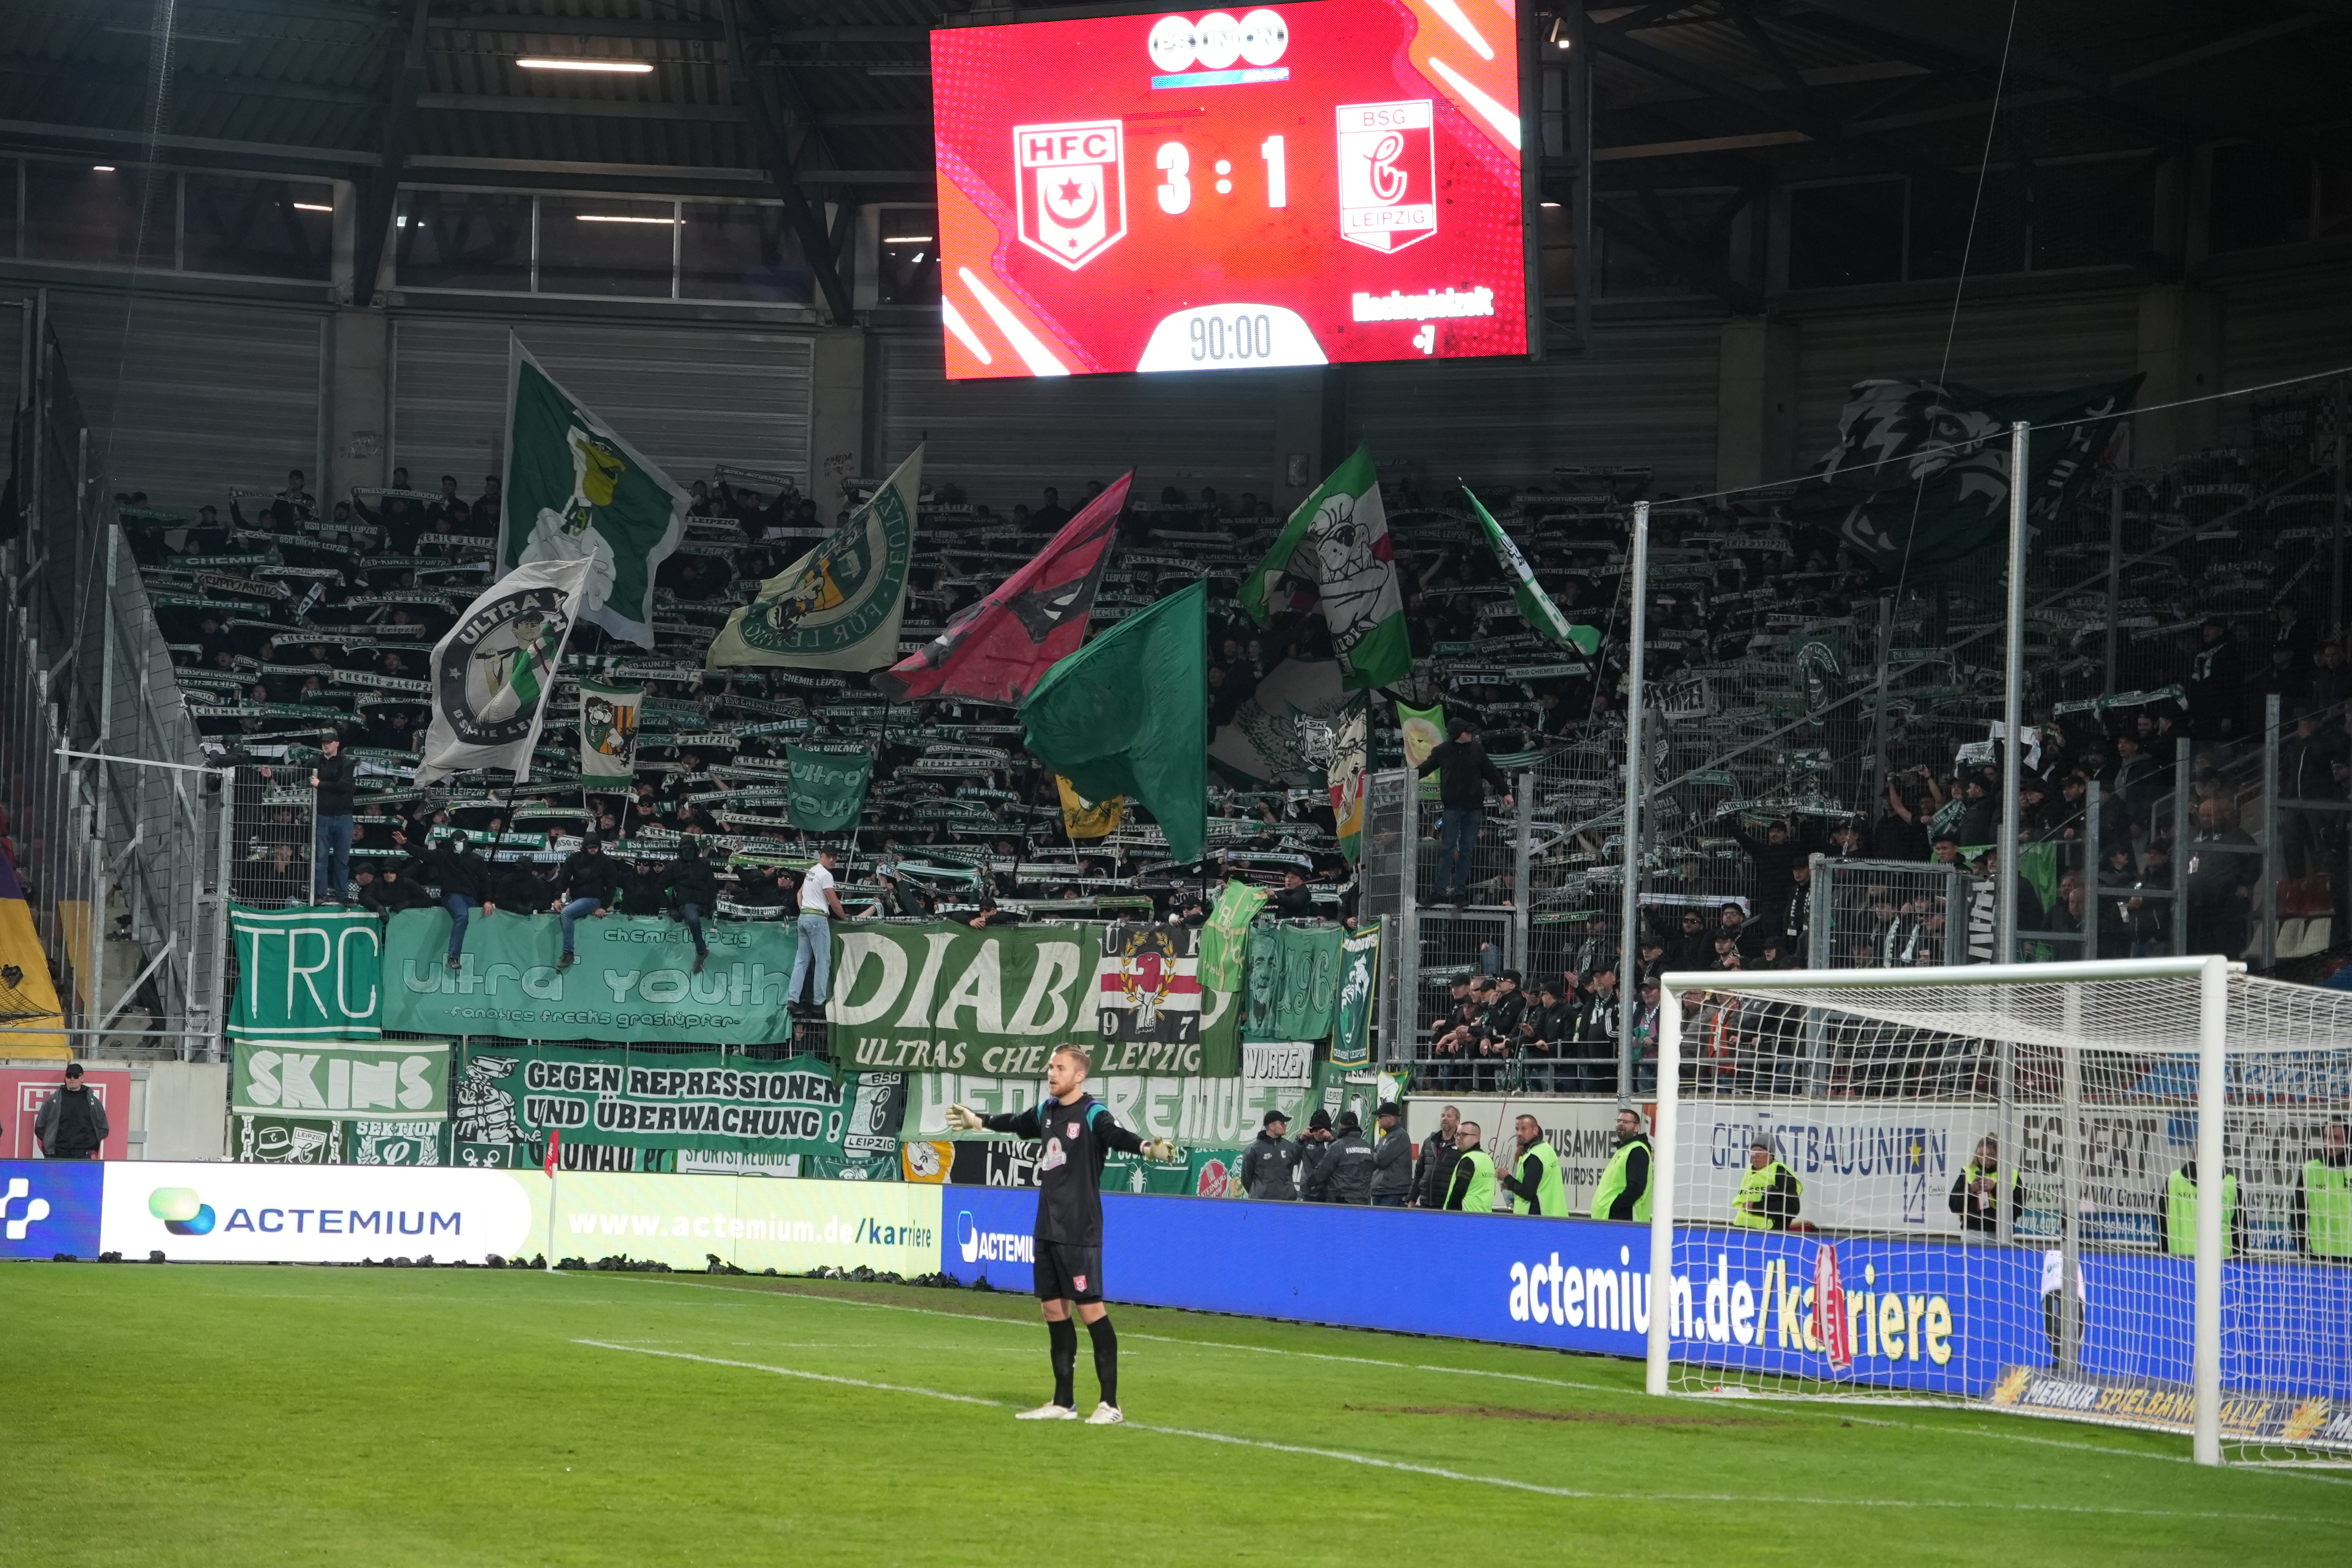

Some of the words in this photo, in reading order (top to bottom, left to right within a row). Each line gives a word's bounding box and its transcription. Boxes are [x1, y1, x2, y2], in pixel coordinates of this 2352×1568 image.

[1363, 109, 1405, 127] BSG
[1029, 133, 1108, 161] HFC
[1156, 141, 1191, 215] 3
[1261, 135, 1286, 208] 1
[1352, 210, 1424, 227] LEIPZIG
[1190, 313, 1271, 361] 90:00
[185, 555, 265, 565] CHEMIE
[170, 597, 253, 609] CHEMIE
[1531, 667, 1555, 675] CHEMIE
[1556, 665, 1581, 674] LEIPZIG
[338, 672, 381, 685] CHEMIE
[782, 673, 815, 686] CHEMIE
[816, 678, 847, 688] LEIPZIG
[195, 707, 242, 715] CHEMIE
[724, 696, 740, 705] BSG
[741, 698, 771, 710] CHEMIE
[770, 704, 801, 717] LEIPZIG
[731, 717, 809, 737] CHEMIE
[692, 735, 733, 745] LEIPZIG
[353, 748, 389, 757] CHEMIE
[390, 750, 420, 761] LEIPZIG
[356, 777, 383, 788] LEIPZIG
[453, 788, 485, 797] LEIPZIG
[488, 833, 541, 845] LEIPZIG
[557, 838, 571, 847] BSG
[627, 840, 642, 848] BSG
[643, 840, 670, 849] CHEMIE
[533, 853, 567, 862] HOFFNUNG
[234, 924, 379, 1020] TRC
[1102, 1012, 1119, 1036] 9
[1179, 1016, 1194, 1041] 7
[855, 1037, 967, 1068] ULTRAS
[1100, 1043, 1202, 1072] LEIPZIG
[1244, 1048, 1312, 1080] WURZEN
[246, 1050, 433, 1110] SKINS
[527, 1061, 623, 1092] GEGEN
[629, 1070, 842, 1105] REPRESSIONEN
[871, 1072, 899, 1084] BSG
[526, 1098, 585, 1125] UND
[297, 1131, 323, 1142] LEIPZIG
[356, 1122, 441, 1137] SEKTION
[848, 1138, 895, 1149] LEIPZIG
[224, 1208, 461, 1235] ACTEMIUM
[569, 1212, 932, 1249] www.actemium.de/karriere
[977, 1231, 1035, 1265] ACTEMI
[2023, 1380, 2099, 1409] MERKUR
